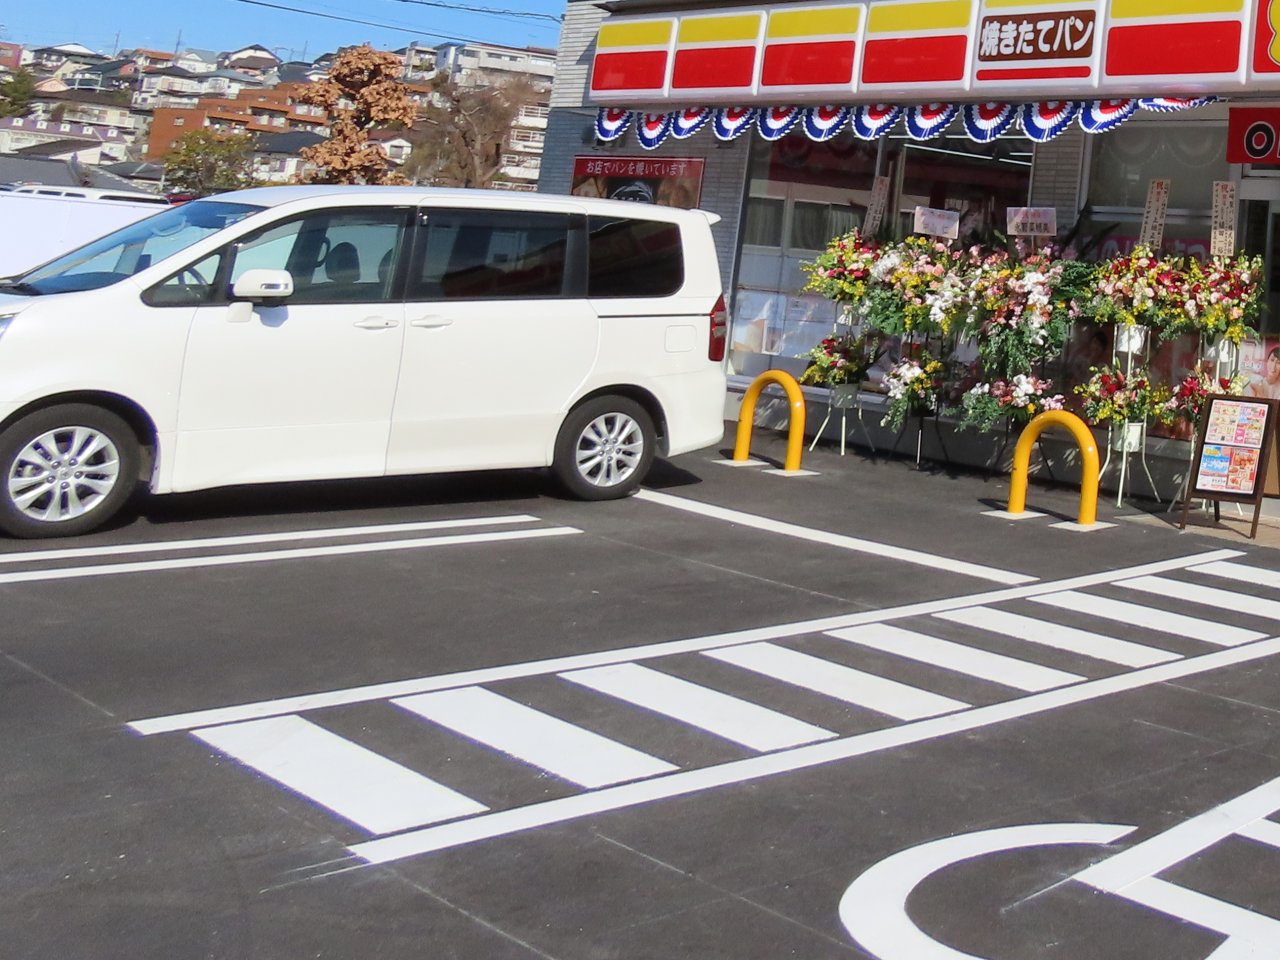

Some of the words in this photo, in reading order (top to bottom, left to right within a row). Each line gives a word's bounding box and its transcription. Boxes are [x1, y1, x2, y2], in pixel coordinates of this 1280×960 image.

[980, 16, 1094, 57] 焼きたてパン
